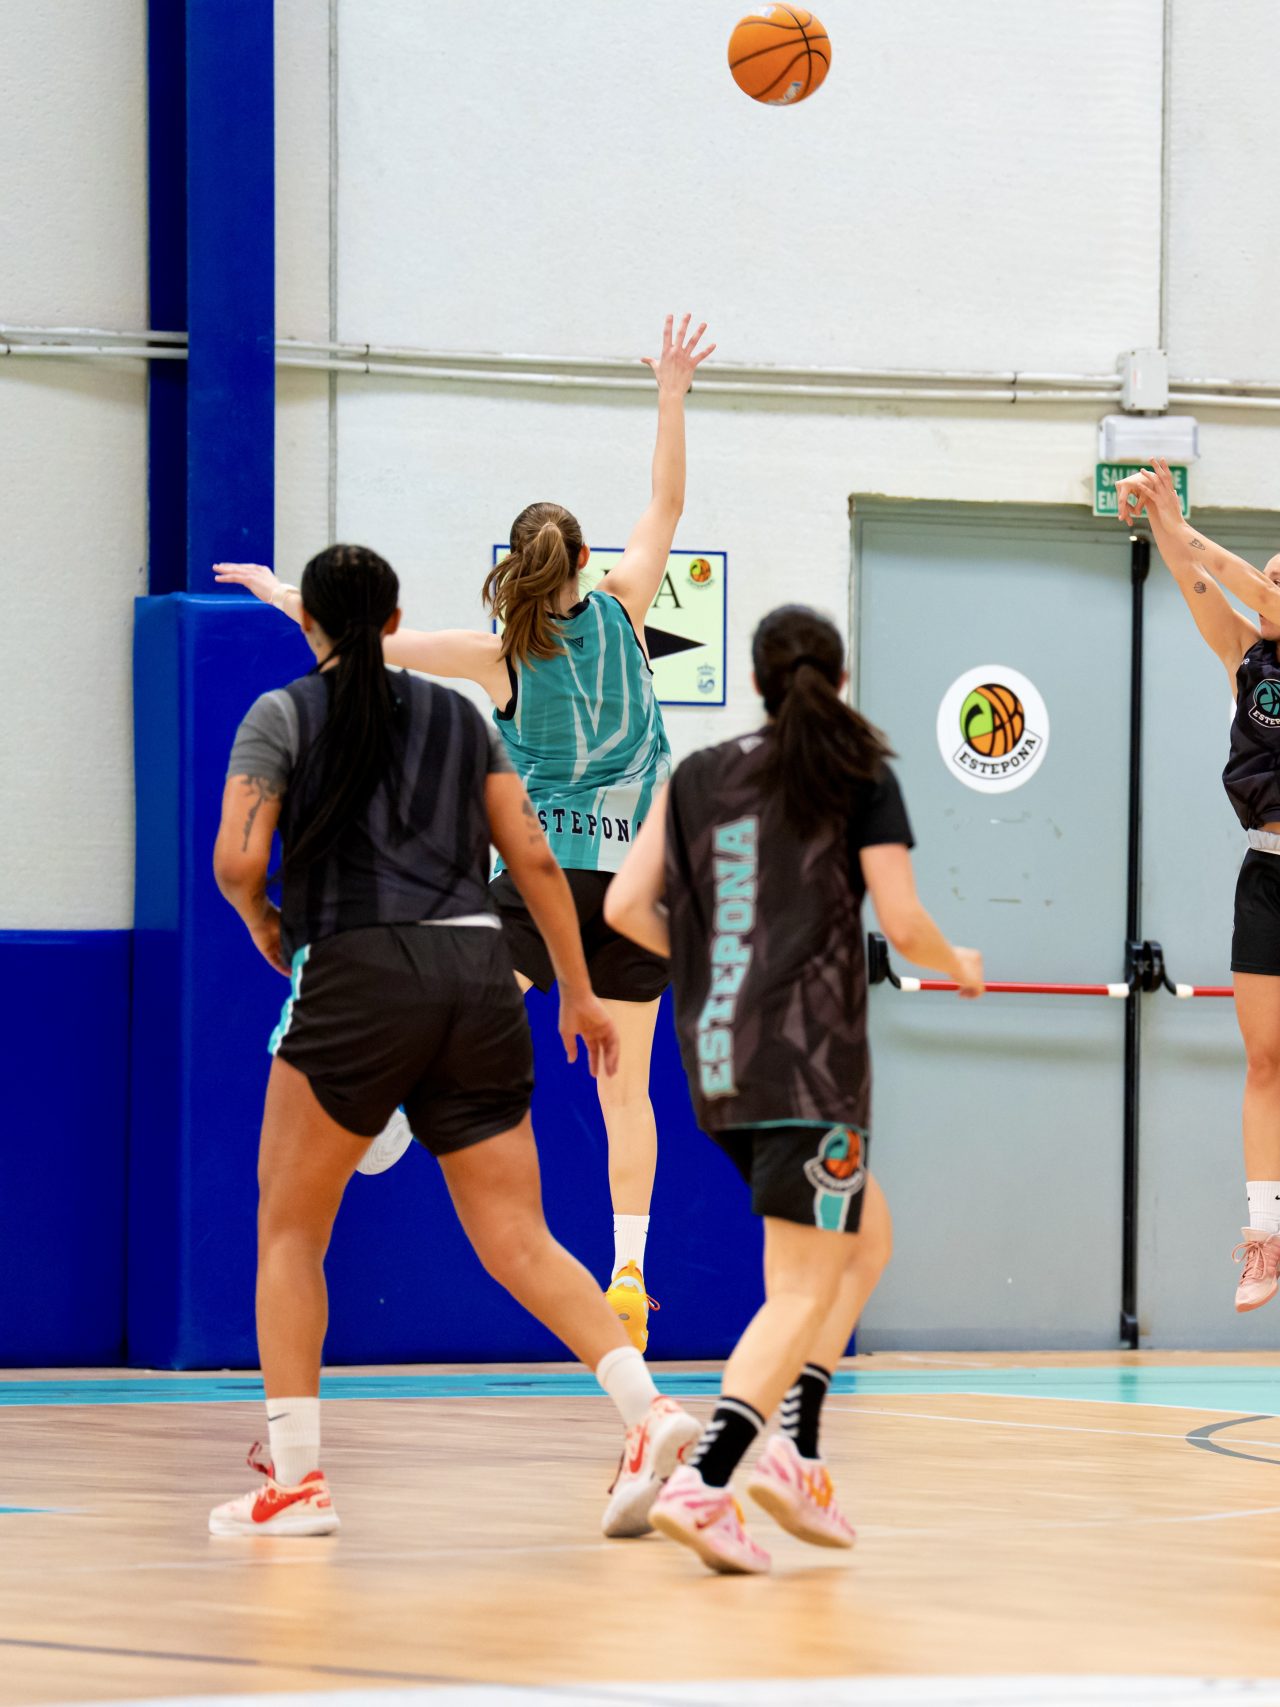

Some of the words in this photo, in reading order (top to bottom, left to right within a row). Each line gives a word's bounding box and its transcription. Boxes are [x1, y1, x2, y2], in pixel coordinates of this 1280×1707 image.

[959, 738, 1037, 775] ESTEPONA
[537, 807, 643, 843] STEPON
[698, 814, 760, 1098] ESTEPONA
